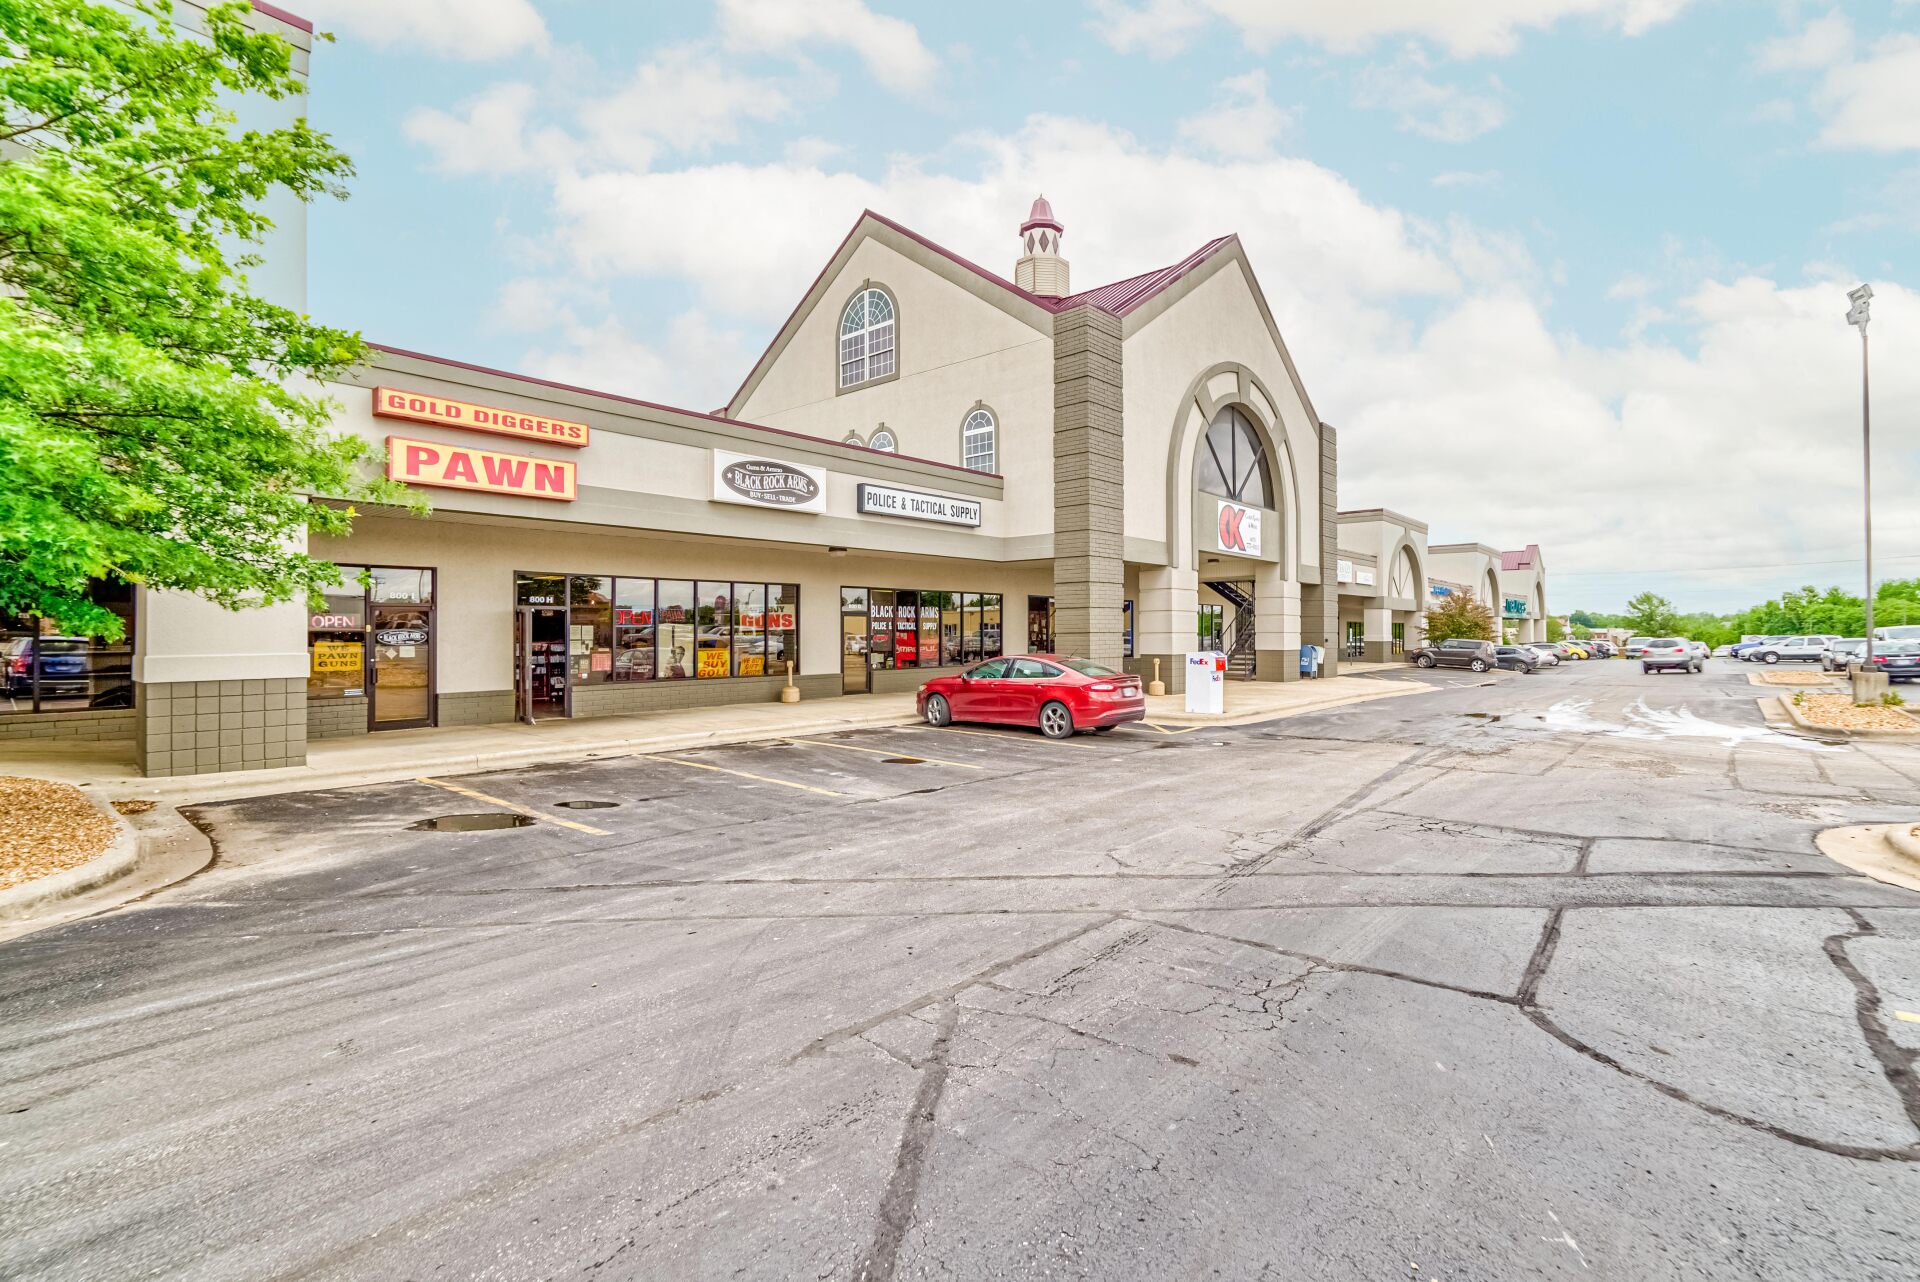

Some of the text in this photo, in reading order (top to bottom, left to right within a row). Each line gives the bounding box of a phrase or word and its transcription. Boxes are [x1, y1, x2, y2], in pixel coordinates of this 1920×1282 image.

[388, 394, 582, 439] GOLD DIGGERS
[405, 444, 565, 494] PAWN
[746, 463, 759, 472] Guns
[734, 470, 808, 493] BLACK ROCK ARMS
[750, 490, 761, 499] BUY
[779, 495, 796, 503] TRADE
[866, 491, 978, 520] POLICE & TACTICAL SUPPLY
[615, 609, 652, 625] OPEN
[870, 605, 939, 619] BLACK ROCK ARMS
[311, 615, 355, 628] OPEN
[741, 613, 793, 628] GUNS
[871, 621, 887, 630] POLICE
[897, 621, 917, 630] TACTICAL
[922, 622, 937, 630] SUPPLY
[327, 645, 350, 653] WE
[704, 652, 724, 661] WE
[1190, 657, 1209, 666] FedEx
[318, 660, 358, 668] GUNS
[703, 660, 728, 669] BUY
